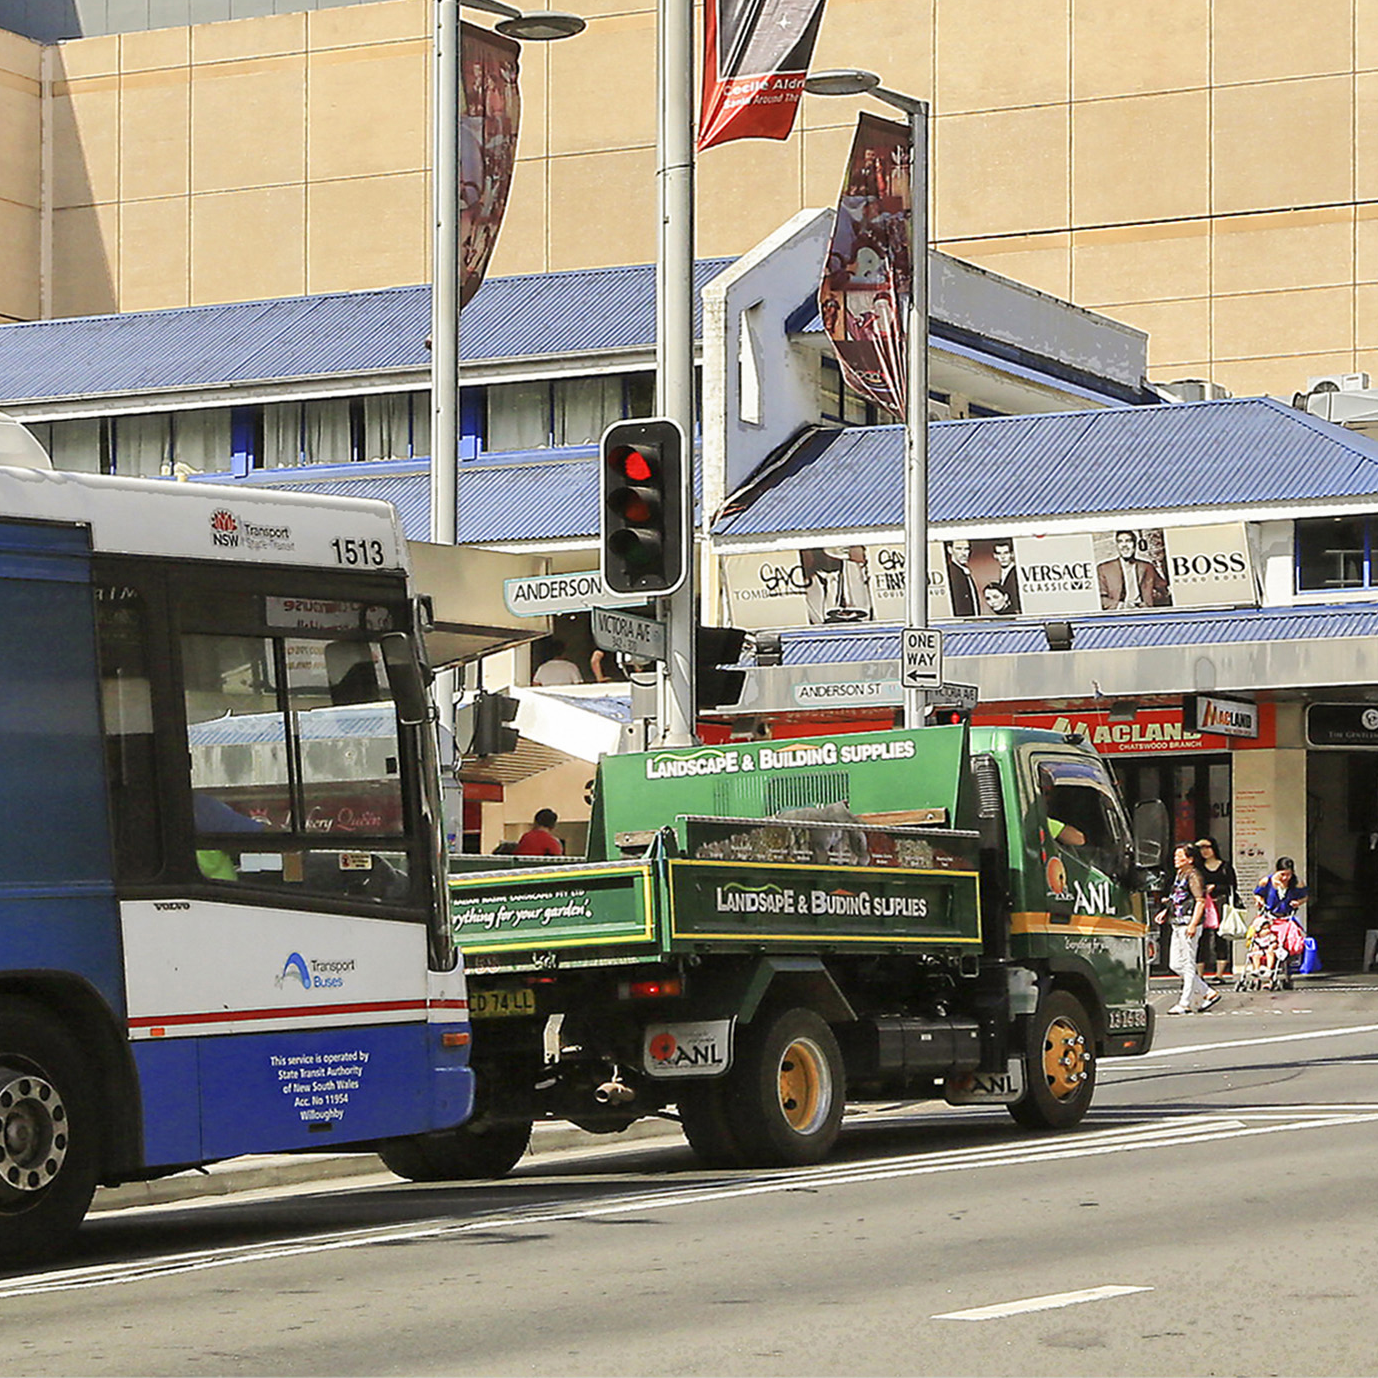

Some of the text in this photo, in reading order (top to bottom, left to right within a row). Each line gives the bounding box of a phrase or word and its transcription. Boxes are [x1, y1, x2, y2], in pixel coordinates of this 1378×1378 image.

[213, 533, 239, 547] NSW
[244, 524, 290, 540] Transport
[331, 537, 385, 566] 1513
[1020, 562, 1093, 583] VERSACE
[1172, 552, 1247, 577] BOSS
[513, 576, 602, 603] ANDERSON
[1022, 582, 1069, 593] CLASSIC
[599, 612, 651, 643] VICTORIA AVE
[908, 634, 936, 649] ONE
[906, 653, 936, 667] WAY
[800, 683, 882, 698] ANDERSON ST
[1118, 740, 1203, 751] CHATSWOOD BRANCH
[646, 740, 916, 779] LANDSCAPE & BUILDING SUPPLIES
[798, 895, 809, 914] &
[1073, 879, 1117, 915] ANL
[452, 906, 495, 932] rything
[494, 905, 514, 928] for
[511, 907, 543, 927] your
[311, 959, 356, 974] Transport
[313, 975, 344, 988] Buses
[270, 1050, 370, 1066] This service is operated by
[675, 1043, 723, 1065] ANL
[278, 1065, 363, 1080] State Transit Authority
[282, 1079, 360, 1094] of New South Wales
[971, 1075, 1019, 1093] ANL
[312, 1095, 324, 1106] No
[325, 1093, 349, 1105] 11954
[300, 1108, 345, 1122] Willoughby
